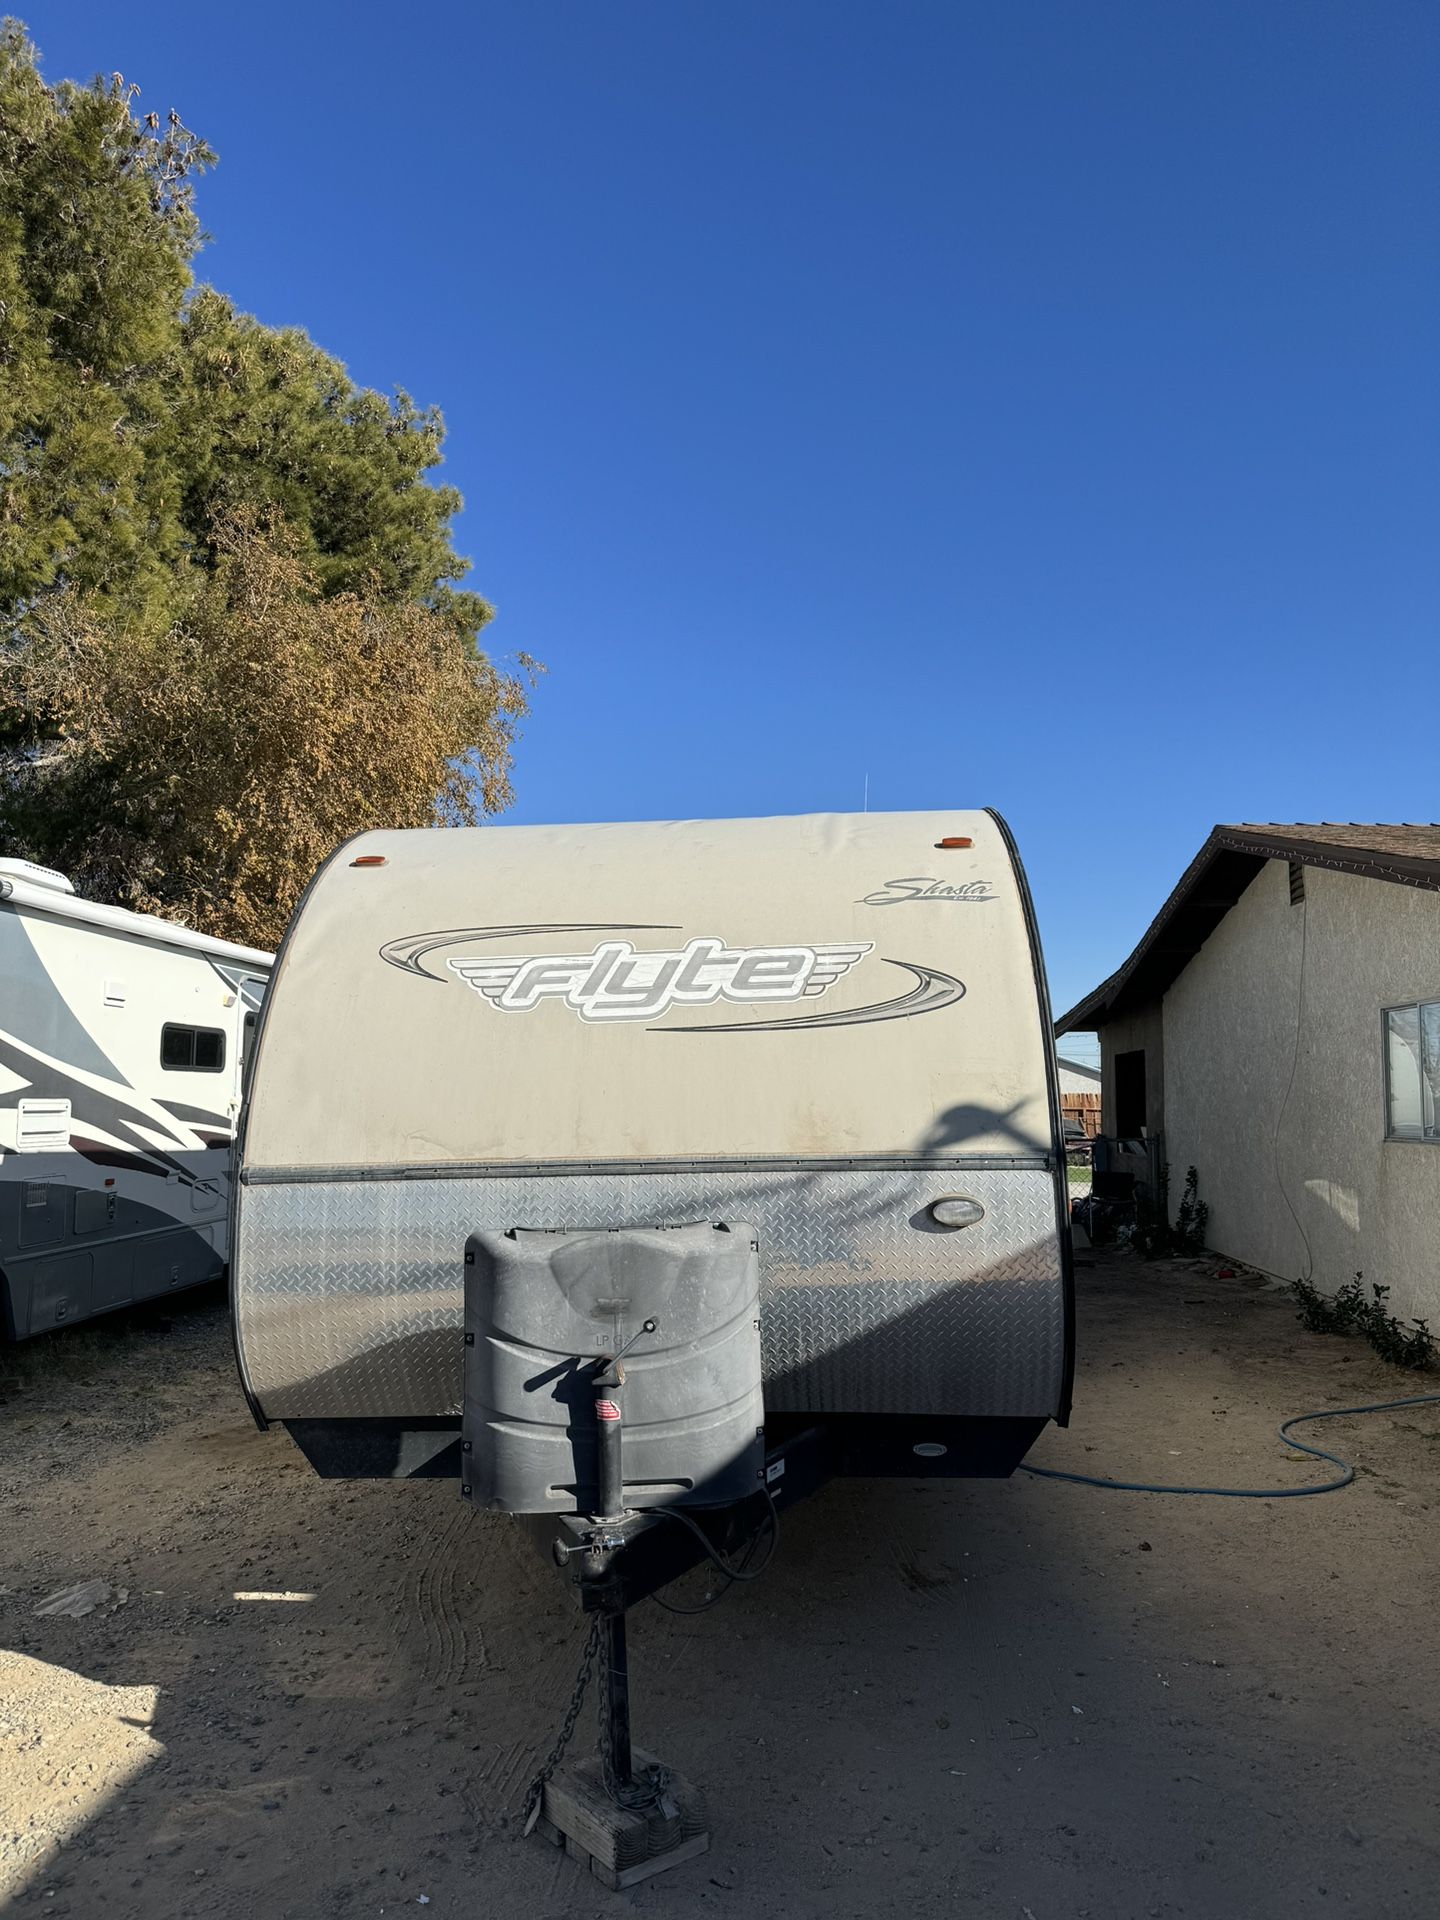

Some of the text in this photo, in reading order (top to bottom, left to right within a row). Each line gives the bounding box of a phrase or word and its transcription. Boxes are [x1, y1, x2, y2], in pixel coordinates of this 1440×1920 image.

[857, 877, 996, 906] Shasta
[507, 943, 809, 1013] Flyte
[596, 1334, 610, 1347] LP
